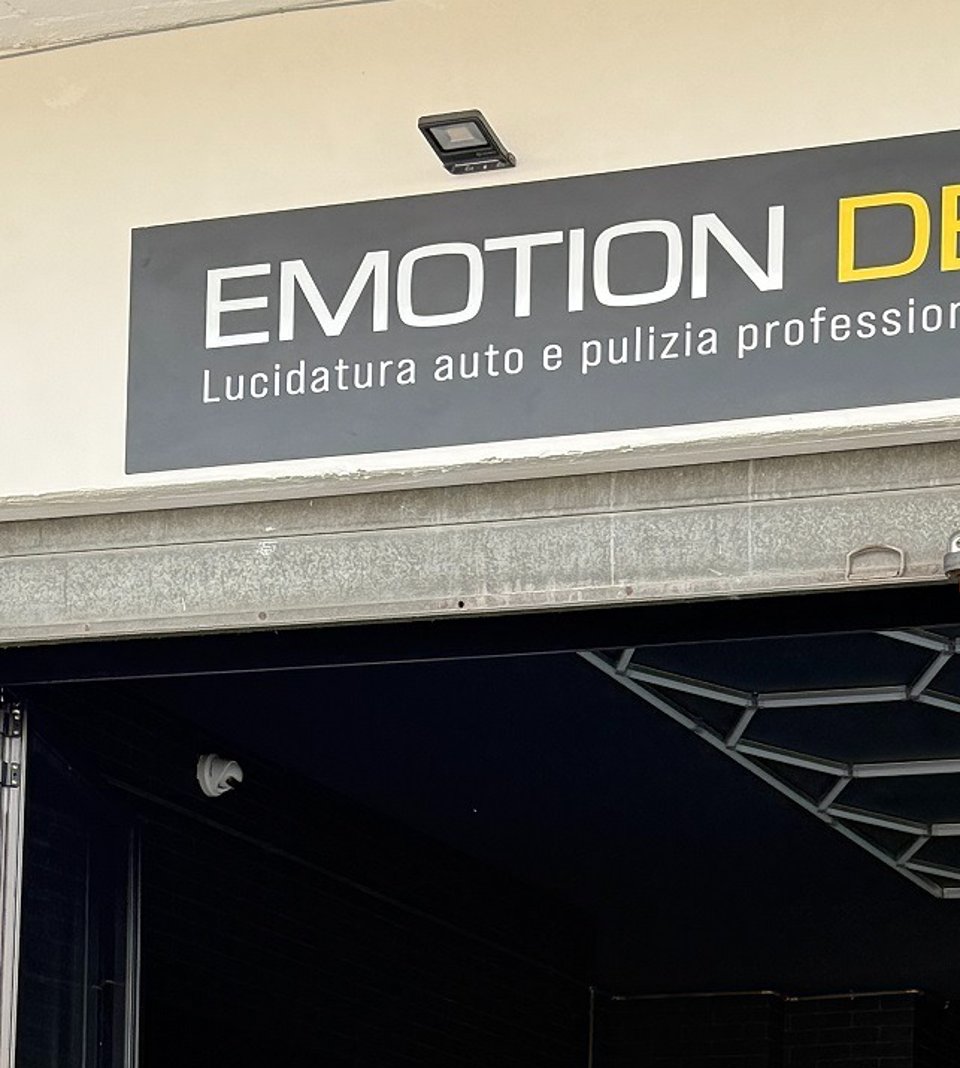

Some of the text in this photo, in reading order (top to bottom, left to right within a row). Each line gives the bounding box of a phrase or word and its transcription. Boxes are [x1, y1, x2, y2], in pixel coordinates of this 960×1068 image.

[205, 205, 785, 350] EMOTION
[202, 358, 416, 404] Lucidatura
[433, 343, 524, 382] auto
[542, 344, 563, 371] e
[581, 321, 718, 375] pulizia
